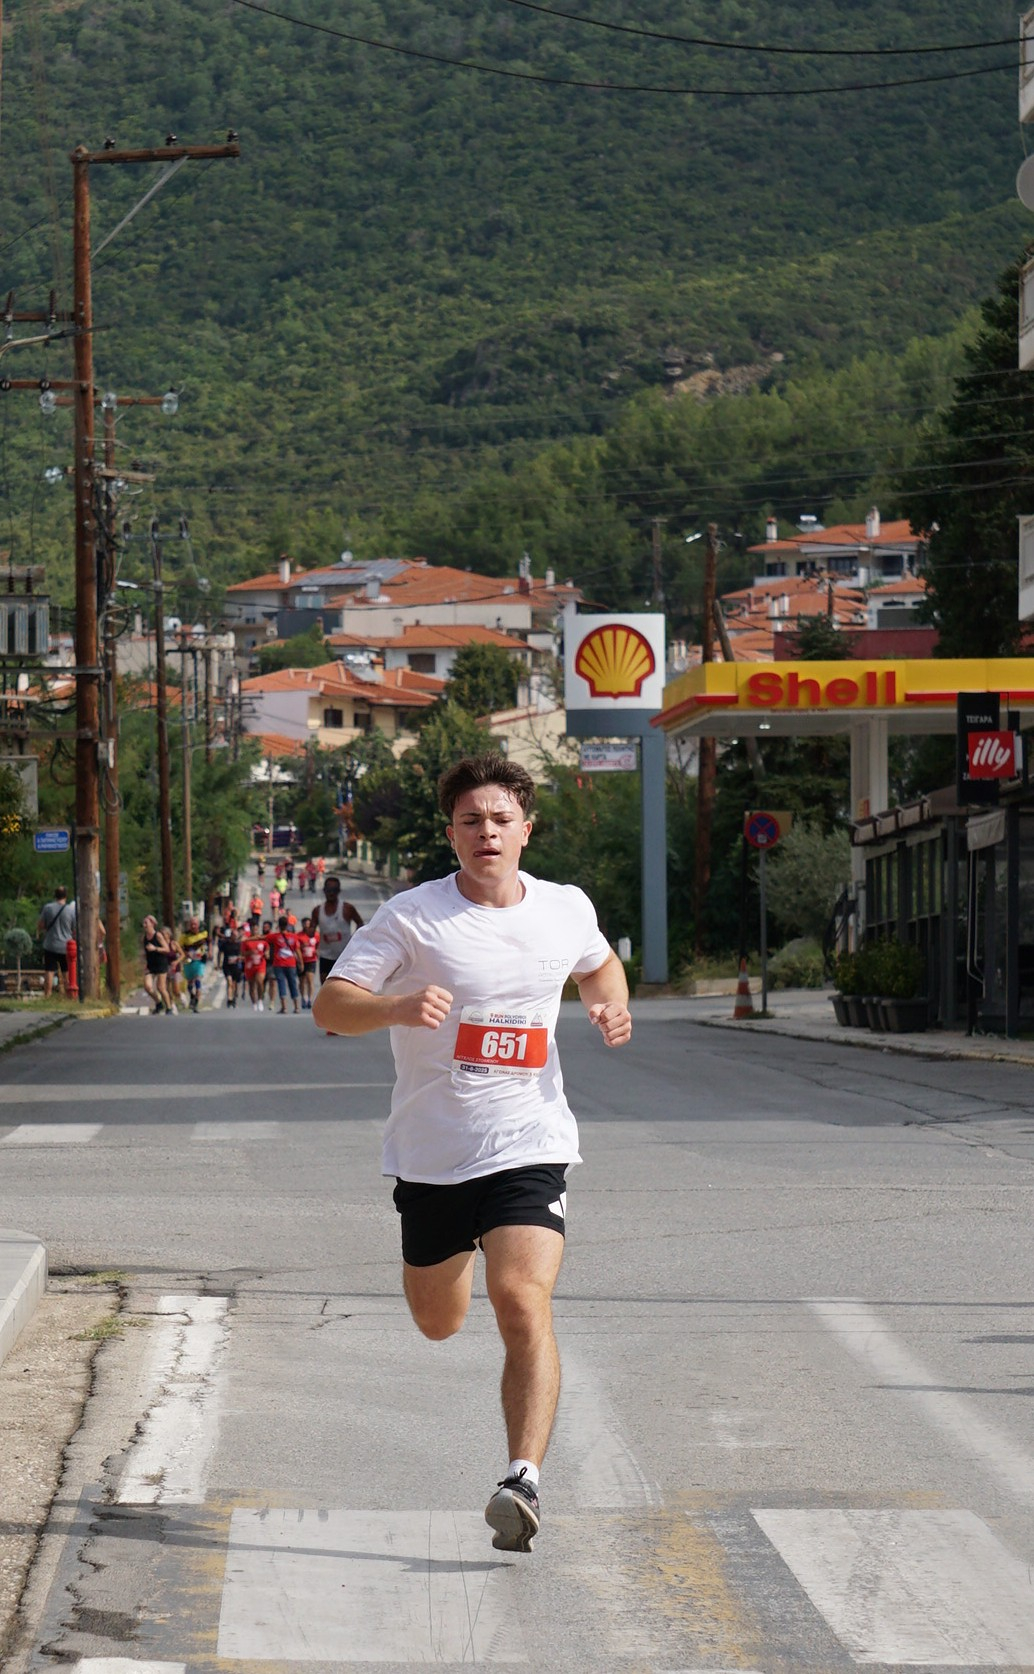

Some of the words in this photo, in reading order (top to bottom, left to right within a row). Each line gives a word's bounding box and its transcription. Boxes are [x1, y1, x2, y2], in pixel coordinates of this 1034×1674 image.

[749, 671, 896, 706] Shell
[973, 738, 1010, 771] illy
[481, 1031, 527, 1060] 651
